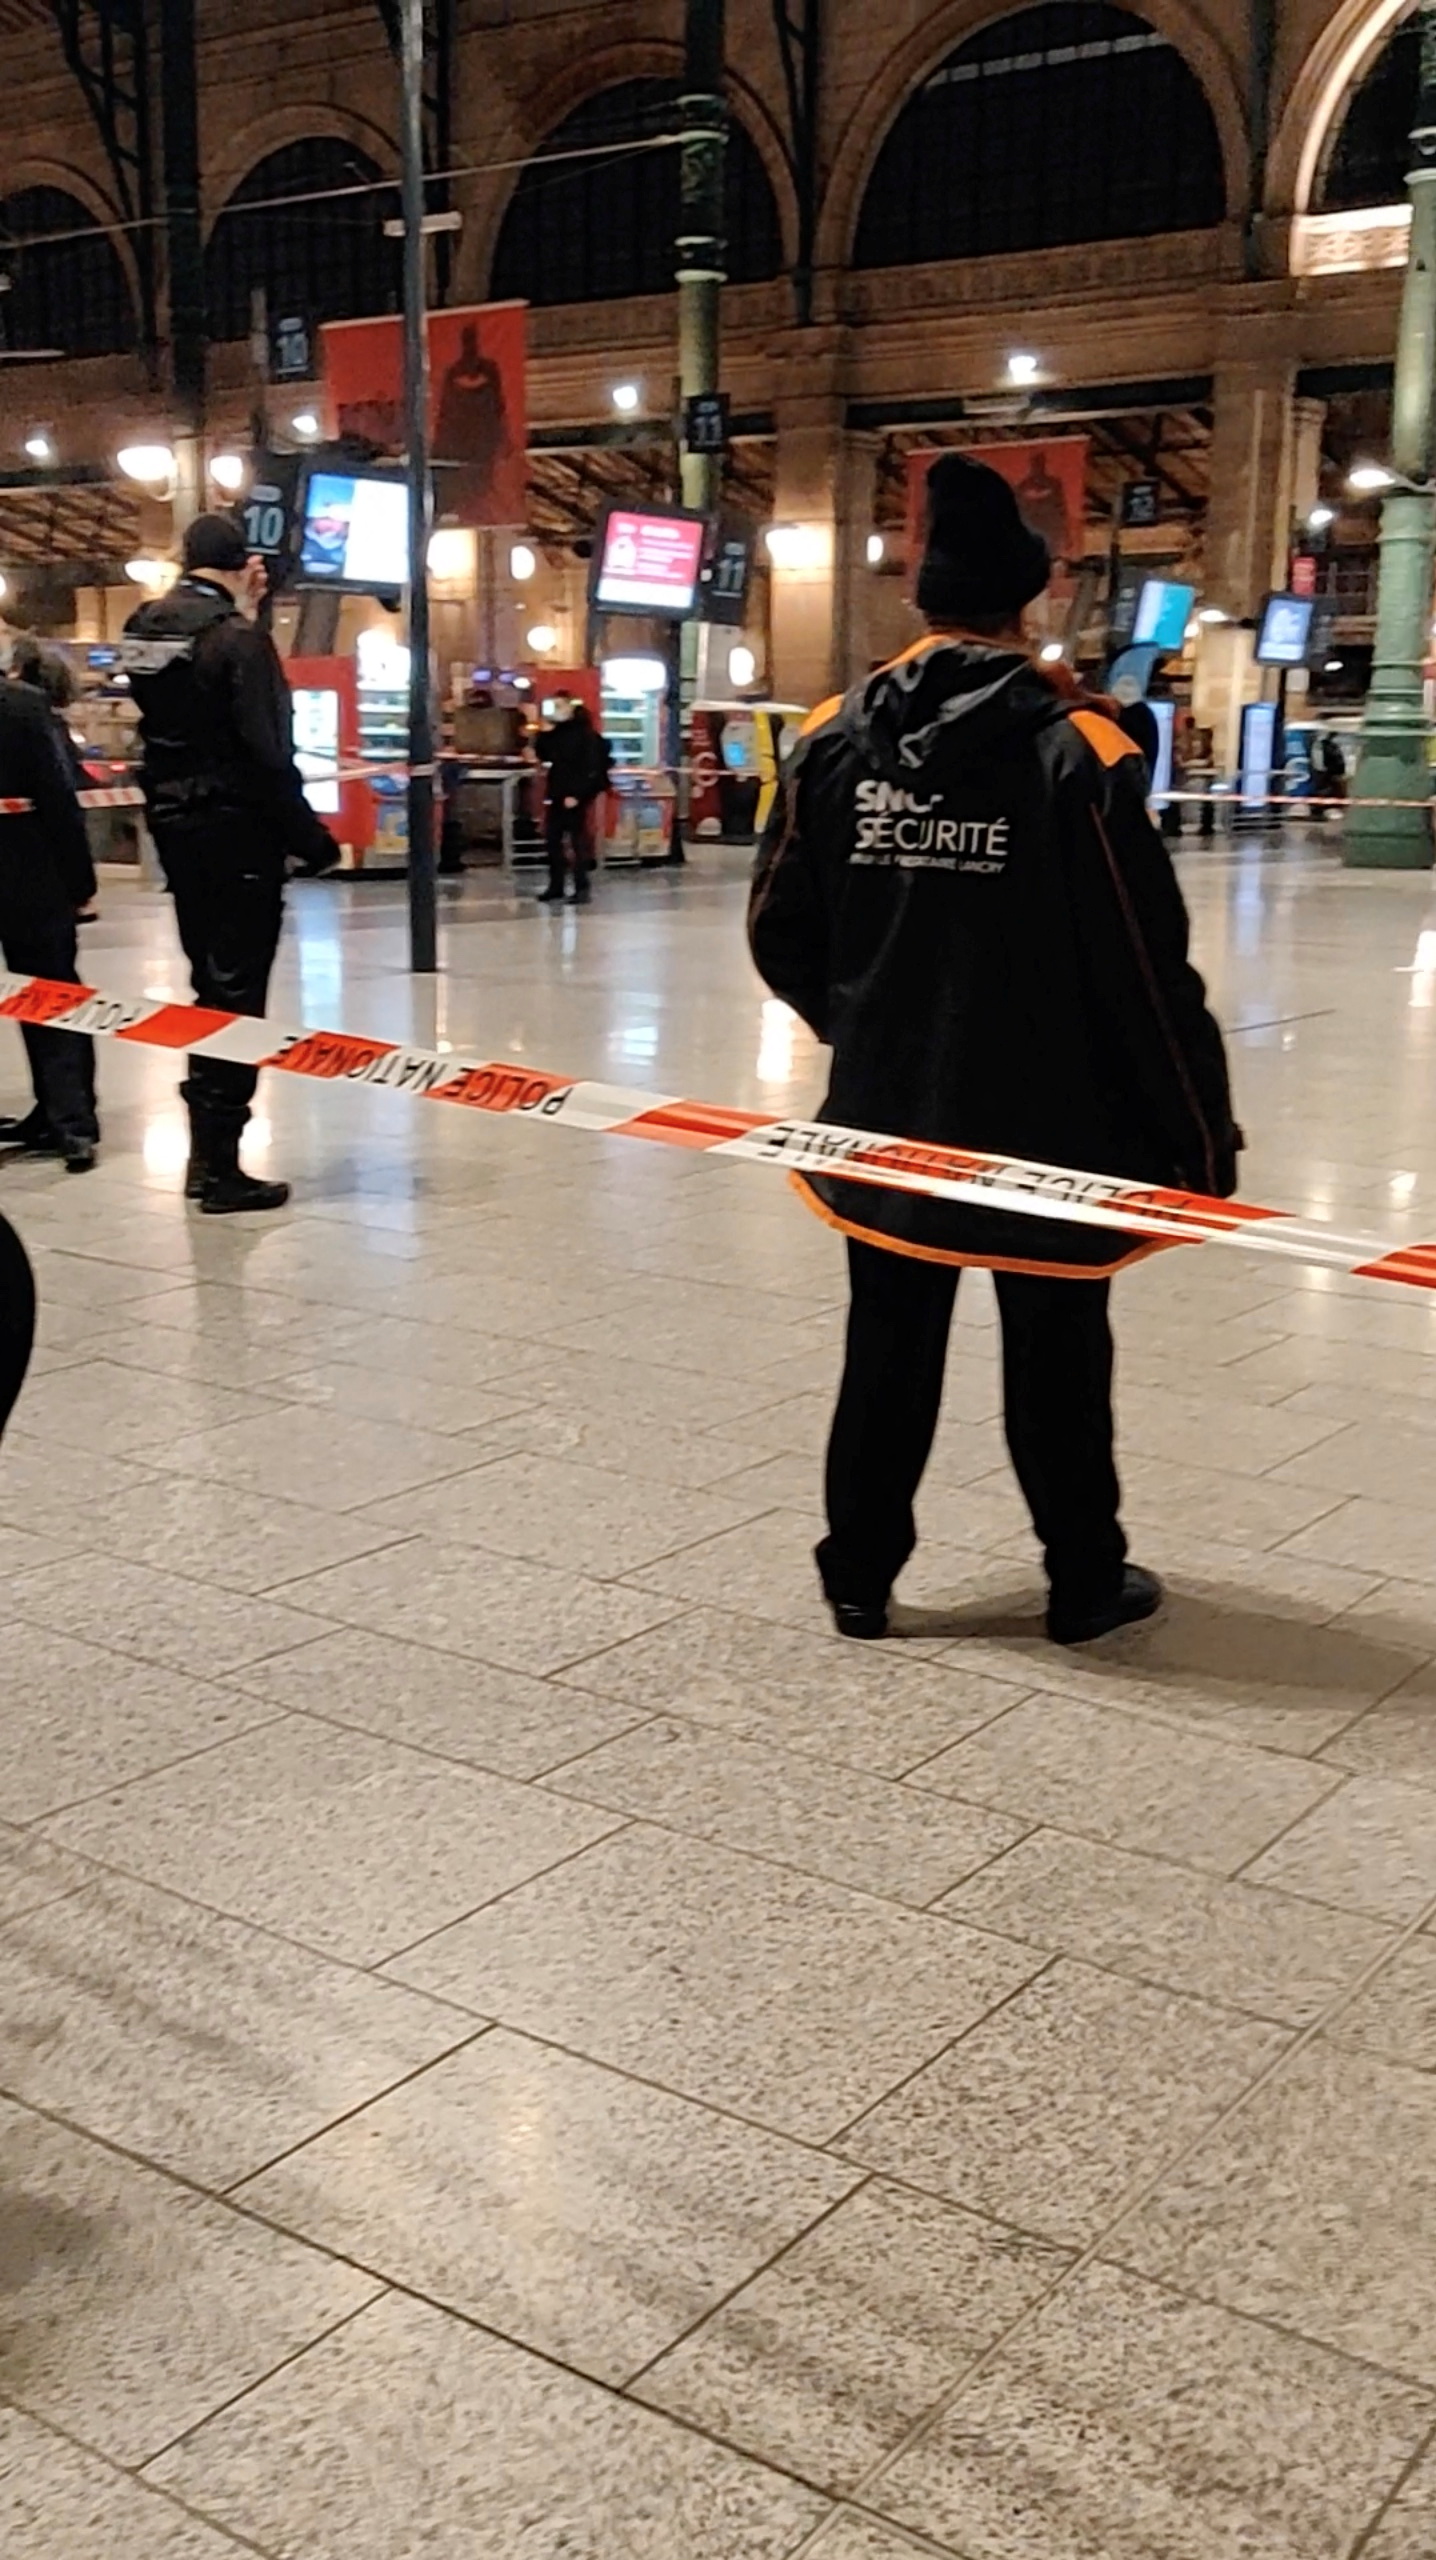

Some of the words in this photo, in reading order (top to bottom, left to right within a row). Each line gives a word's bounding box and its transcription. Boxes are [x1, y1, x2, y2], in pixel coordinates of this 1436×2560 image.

[694, 415, 721, 440] 11
[243, 505, 284, 546] 10
[718, 558, 745, 590] 11
[854, 810, 1010, 856] SÉCURITÉ
[265, 1035, 448, 1092] NATIONALE
[444, 1067, 575, 1117] POLICE
